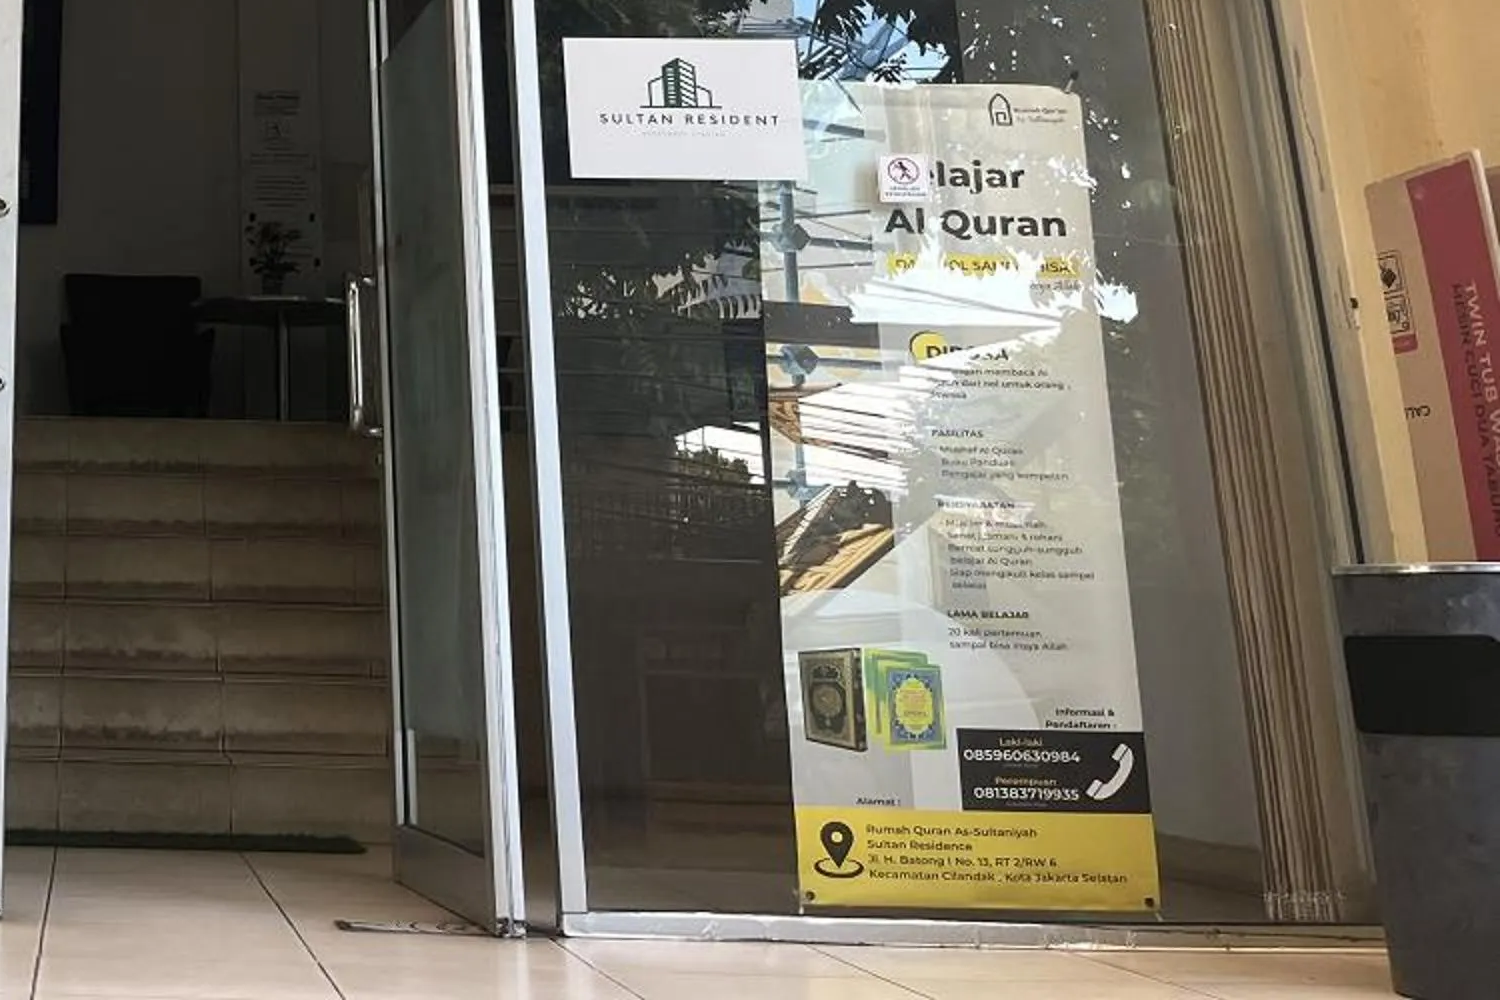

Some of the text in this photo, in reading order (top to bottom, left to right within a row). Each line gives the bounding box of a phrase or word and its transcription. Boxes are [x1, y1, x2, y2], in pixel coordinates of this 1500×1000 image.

[600, 114, 780, 126] SULTAN RESIDENT
[930, 160, 1025, 195] lajar
[884, 207, 1067, 240] Al Quran
[1464, 278, 1487, 347] TWIN
[1479, 351, 1499, 403] TUB
[948, 610, 978, 619] LAMA
[963, 749, 1081, 763] 085960630984
[974, 786, 1080, 801] 081383719935
[866, 824, 1038, 839] Rumah Quran As-Sultaniyah
[867, 840, 973, 851] Sultan Residence
[995, 858, 1012, 868] RT
[1013, 857, 1047, 868] 2/RW
[869, 870, 939, 881] Kecamatan
[1004, 872, 1032, 883] Kota
[1034, 873, 1078, 884] Jakarta
[1081, 872, 1128, 884] Selatan
